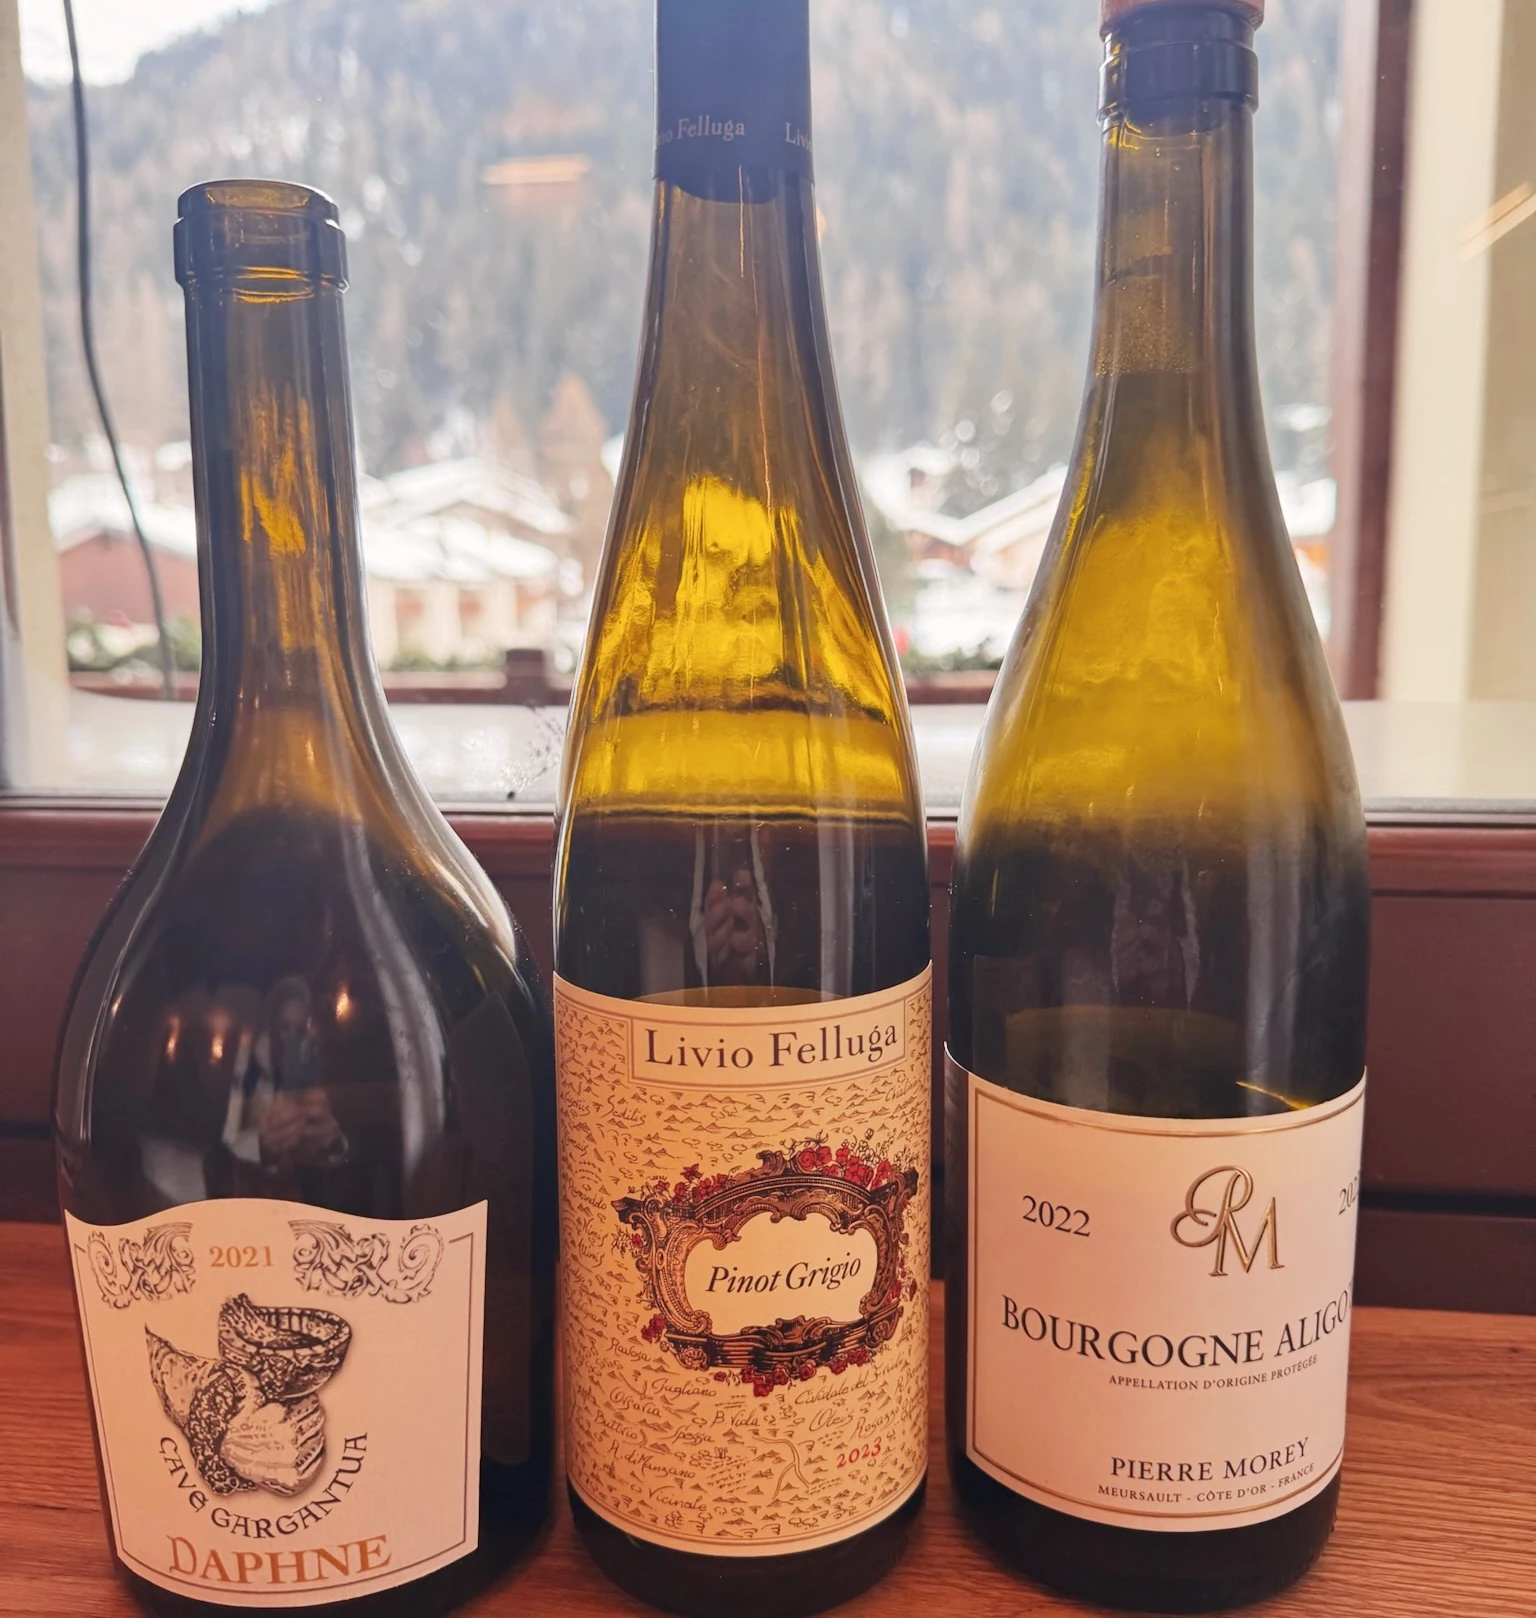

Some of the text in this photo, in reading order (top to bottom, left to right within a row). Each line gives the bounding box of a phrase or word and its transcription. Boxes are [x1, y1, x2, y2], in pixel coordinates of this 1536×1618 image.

[676, 114, 746, 142] Felluga
[645, 1024, 898, 1069] Livio Felluga
[1022, 1195, 1091, 1238] 2022
[1338, 1176, 1359, 1216] 202
[210, 1245, 274, 1268] 2021
[705, 1252, 861, 1293] Pinot Grigio
[1001, 1282, 1351, 1368] BOURGOGNE ALIGO
[1108, 1352, 1318, 1391] APPELLATION D'ORIGINE PROTÉGÉE
[836, 1436, 881, 1468] 2023
[1110, 1436, 1310, 1483] PIERRE MOREY
[211, 1432, 367, 1539] GARGANTUA
[649, 1485, 708, 1511] Vicinale
[1097, 1484, 1182, 1504] MEURSAULT
[1196, 1484, 1234, 1503] CÔTE
[1236, 1483, 1267, 1500] D'OR
[1278, 1462, 1315, 1489] FRANCE
[166, 1535, 393, 1585] DAPHNE
